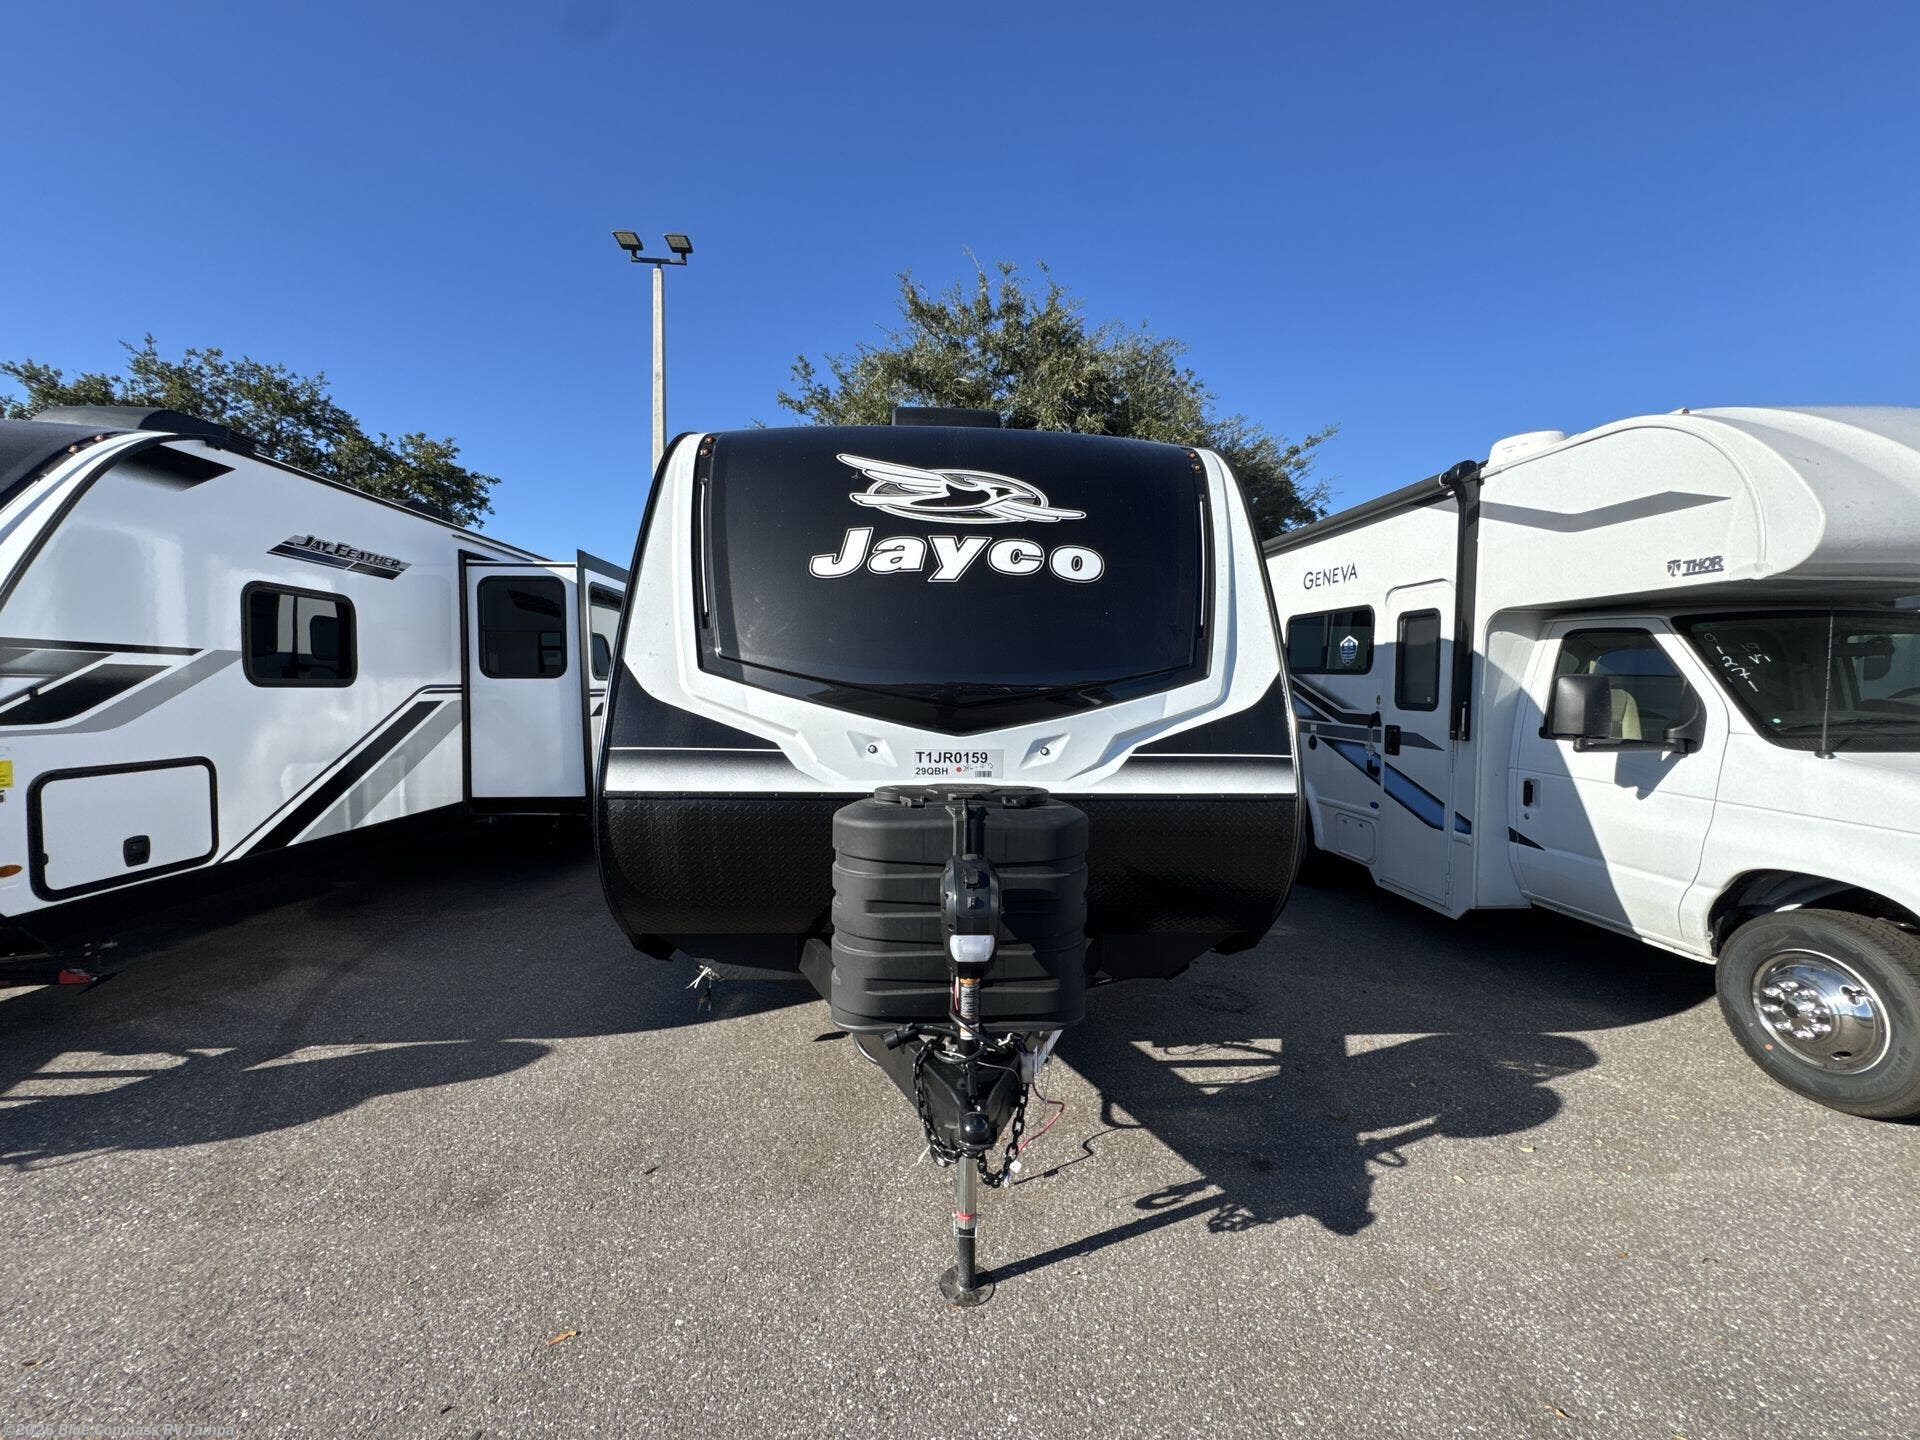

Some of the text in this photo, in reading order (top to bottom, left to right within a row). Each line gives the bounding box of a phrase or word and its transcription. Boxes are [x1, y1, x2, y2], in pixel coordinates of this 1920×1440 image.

[296, 534, 401, 570] JAY FEATHER
[809, 527, 1105, 583] Jayco
[1303, 561, 1358, 590] GENEVA
[1682, 555, 1724, 573] THOR
[915, 751, 988, 764] T1JR0159
[915, 767, 949, 776] 29QBH
